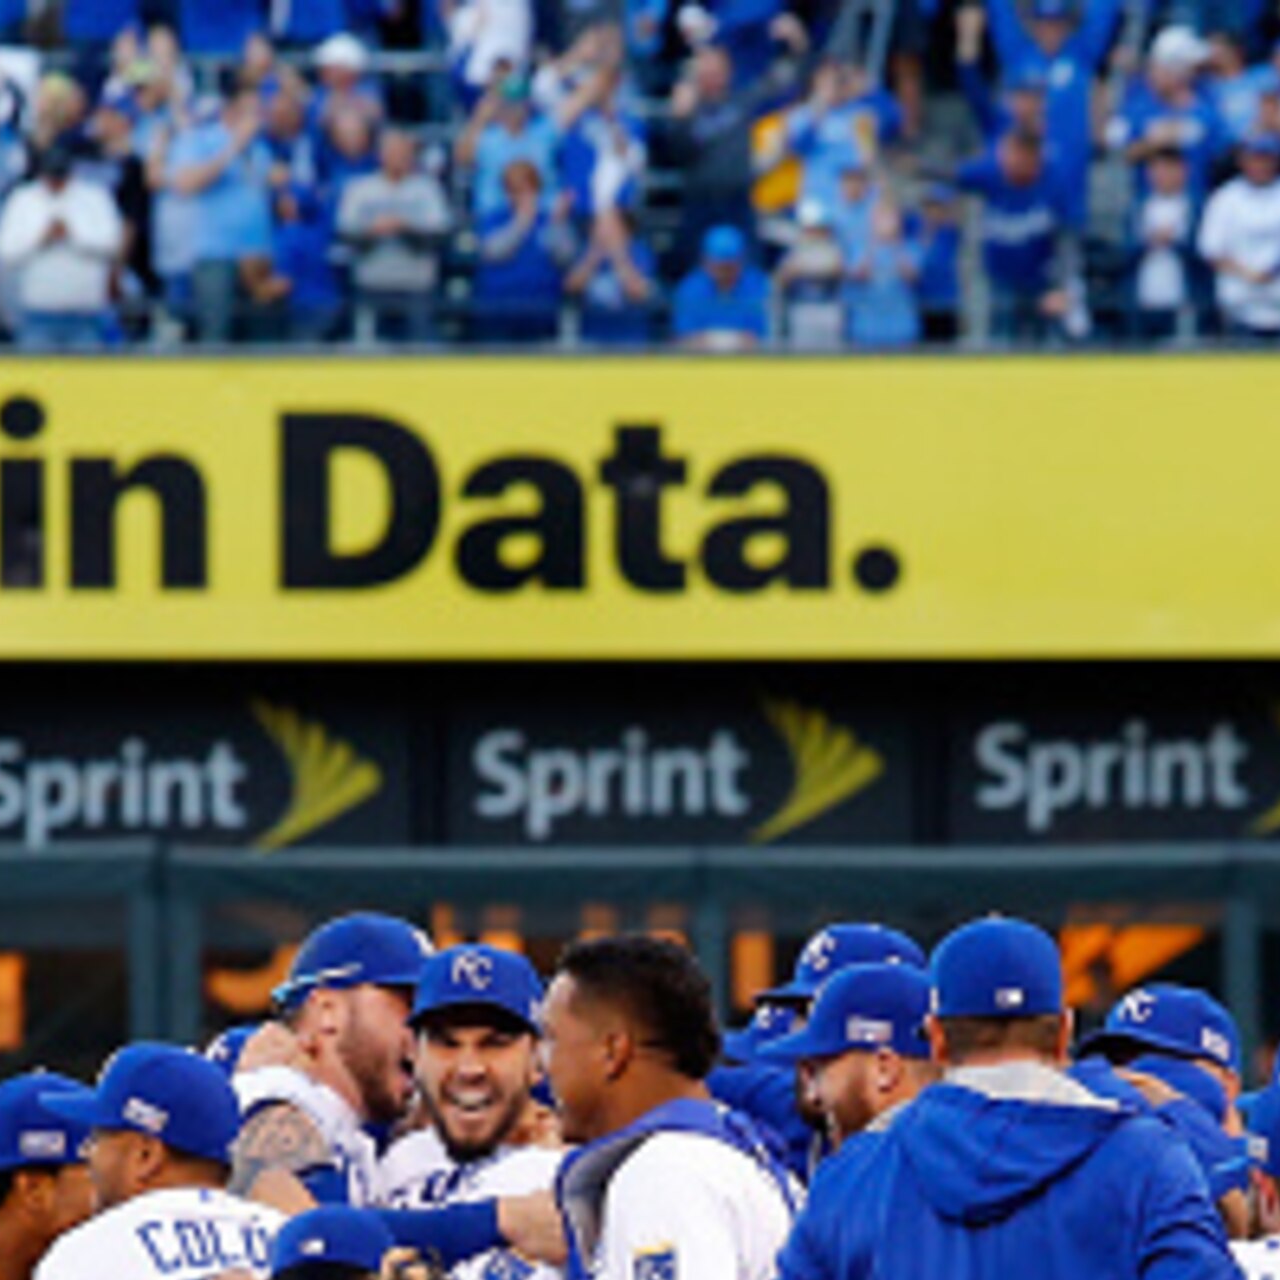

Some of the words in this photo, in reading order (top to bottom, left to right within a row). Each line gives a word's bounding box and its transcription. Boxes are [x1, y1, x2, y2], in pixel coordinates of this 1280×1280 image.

[277, 411, 902, 594] Data.
[472, 727, 751, 839] Sprint
[975, 719, 1250, 831] Sprint
